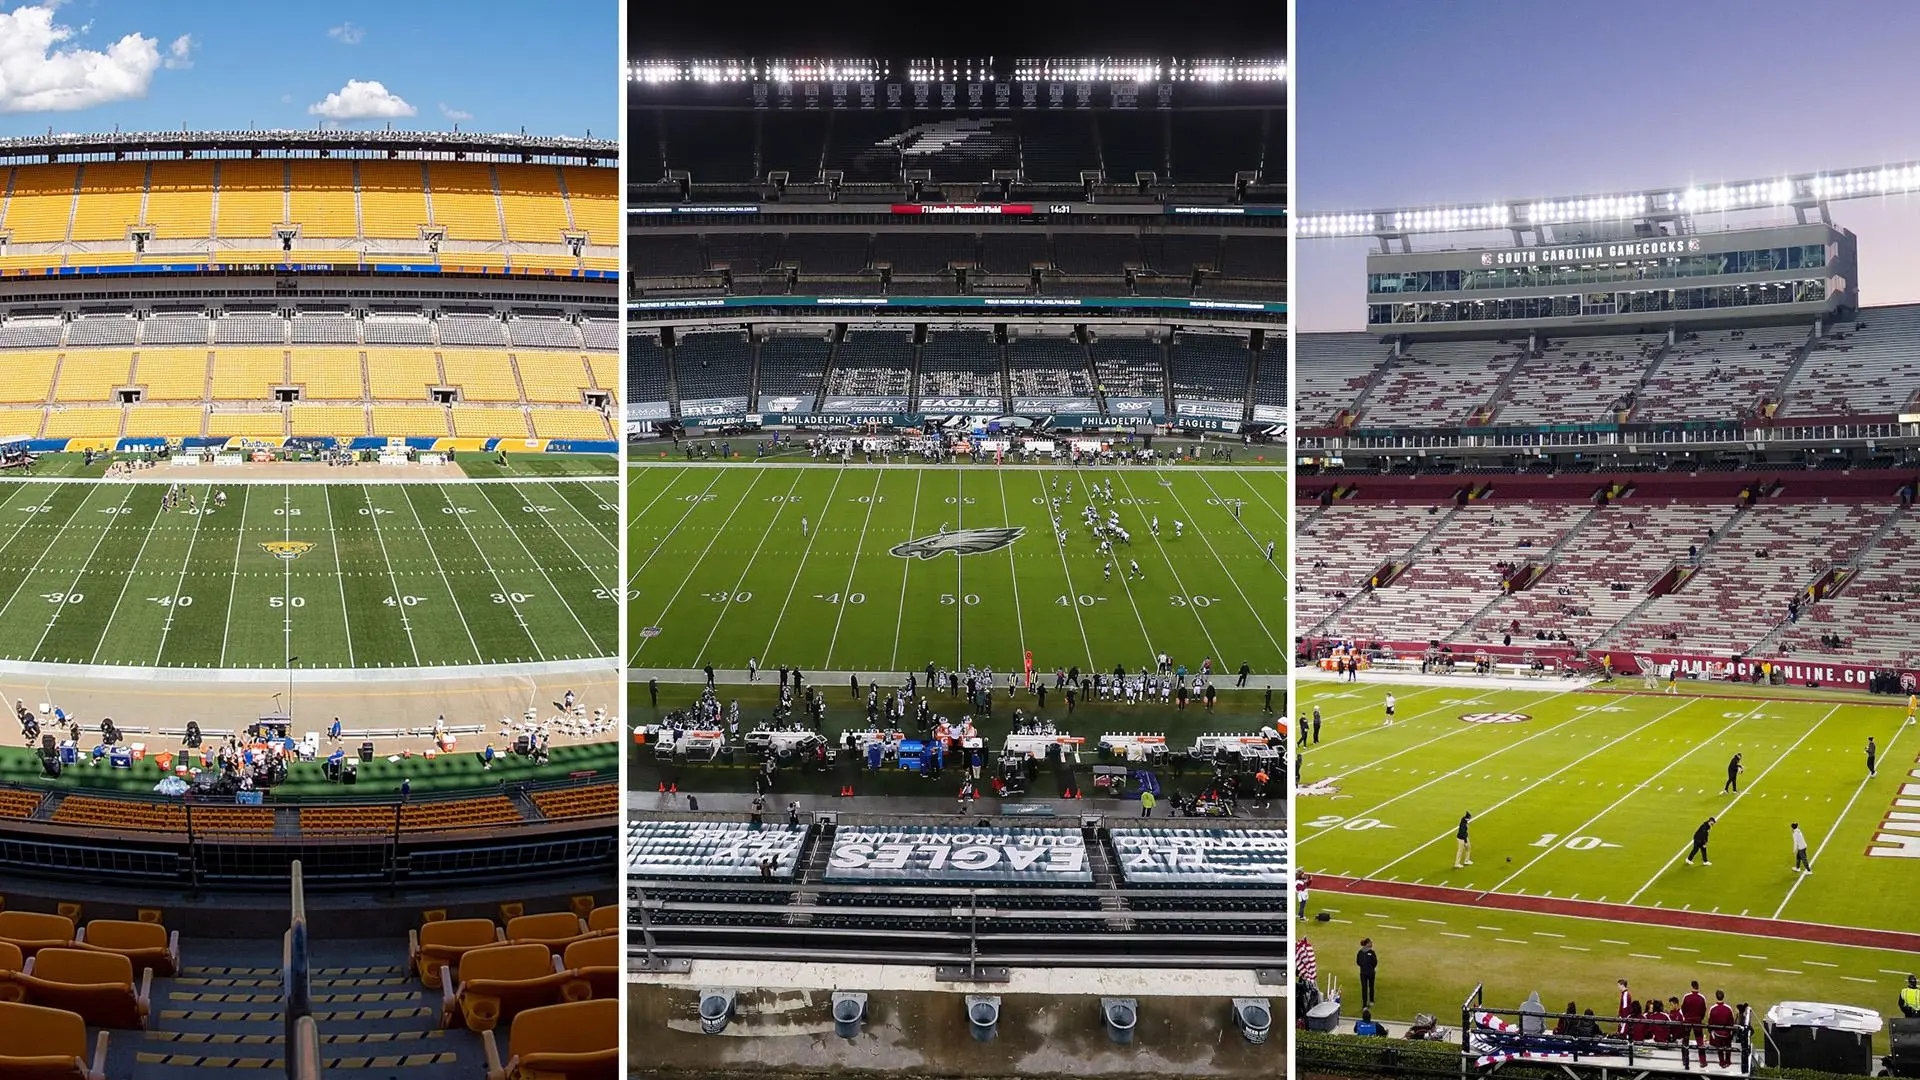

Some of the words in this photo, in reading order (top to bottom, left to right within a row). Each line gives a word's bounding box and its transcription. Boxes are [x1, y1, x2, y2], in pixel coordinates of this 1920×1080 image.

[929, 205, 953, 214] Lincoln
[954, 205, 983, 214] Financial
[984, 205, 1001, 214] Field
[1050, 205, 1070, 214] 14:31
[1497, 251, 1536, 264] SOUTH
[1542, 246, 1603, 261] CAROLINA
[1609, 240, 1684, 257] GAMECOCKS
[879, 399, 905, 407] FLY
[919, 399, 1000, 407] EAGLES
[688, 405, 724, 416] nrg
[781, 415, 851, 424] PHILADELPHIA
[856, 415, 894, 424] EAGLES
[1081, 417, 1153, 425] PHILADELPHIA
[1178, 418, 1217, 429] EAGLES
[240, 438, 275, 449] Panthers
[944, 497, 976, 505] 50
[273, 508, 302, 516] 50
[48, 592, 85, 604] 30
[157, 596, 193, 607] 40
[269, 596, 306, 608] 50
[382, 595, 419, 607] 40
[490, 592, 526, 604] 30
[711, 591, 753, 603] 30
[824, 592, 866, 604] 40
[940, 593, 980, 606] 50
[1054, 593, 1096, 607] 40
[1170, 593, 1211, 607] 30
[1301, 815, 1381, 831] 20
[842, 832, 905, 845] LINE
[911, 833, 1008, 846] FRONT
[1019, 835, 1085, 847] OUR
[1527, 833, 1603, 851] 10
[829, 845, 1085, 871] EAGLES
[1126, 848, 1206, 866] FLY
